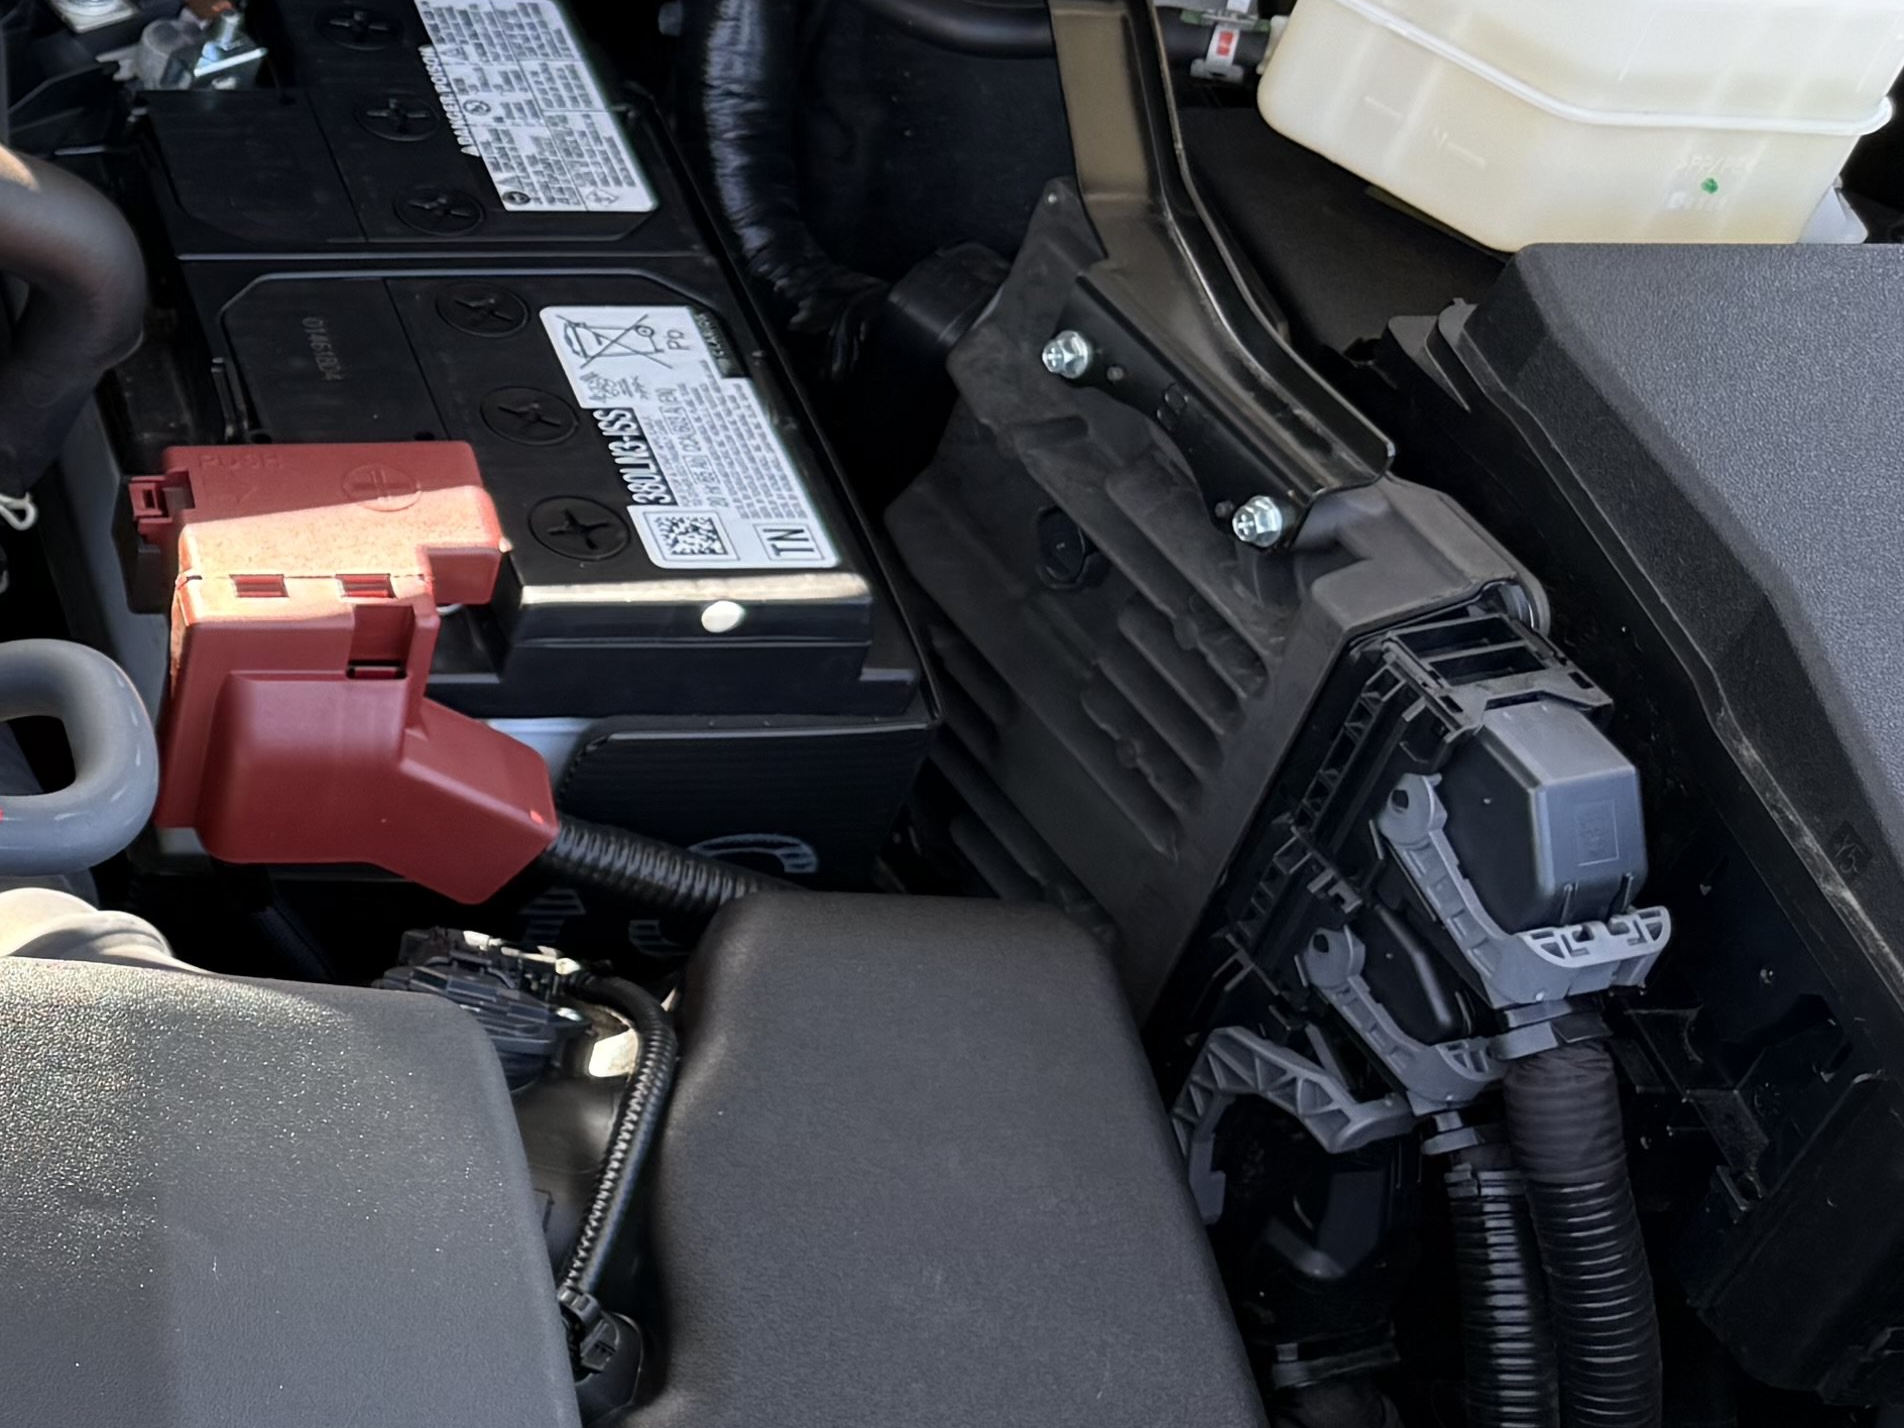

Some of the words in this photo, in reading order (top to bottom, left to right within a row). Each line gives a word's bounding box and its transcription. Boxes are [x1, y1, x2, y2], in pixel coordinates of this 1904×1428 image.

[666, 329, 690, 351] Pb
[592, 409, 672, 505] 380LN3-ISS
[761, 527, 815, 557] TN
